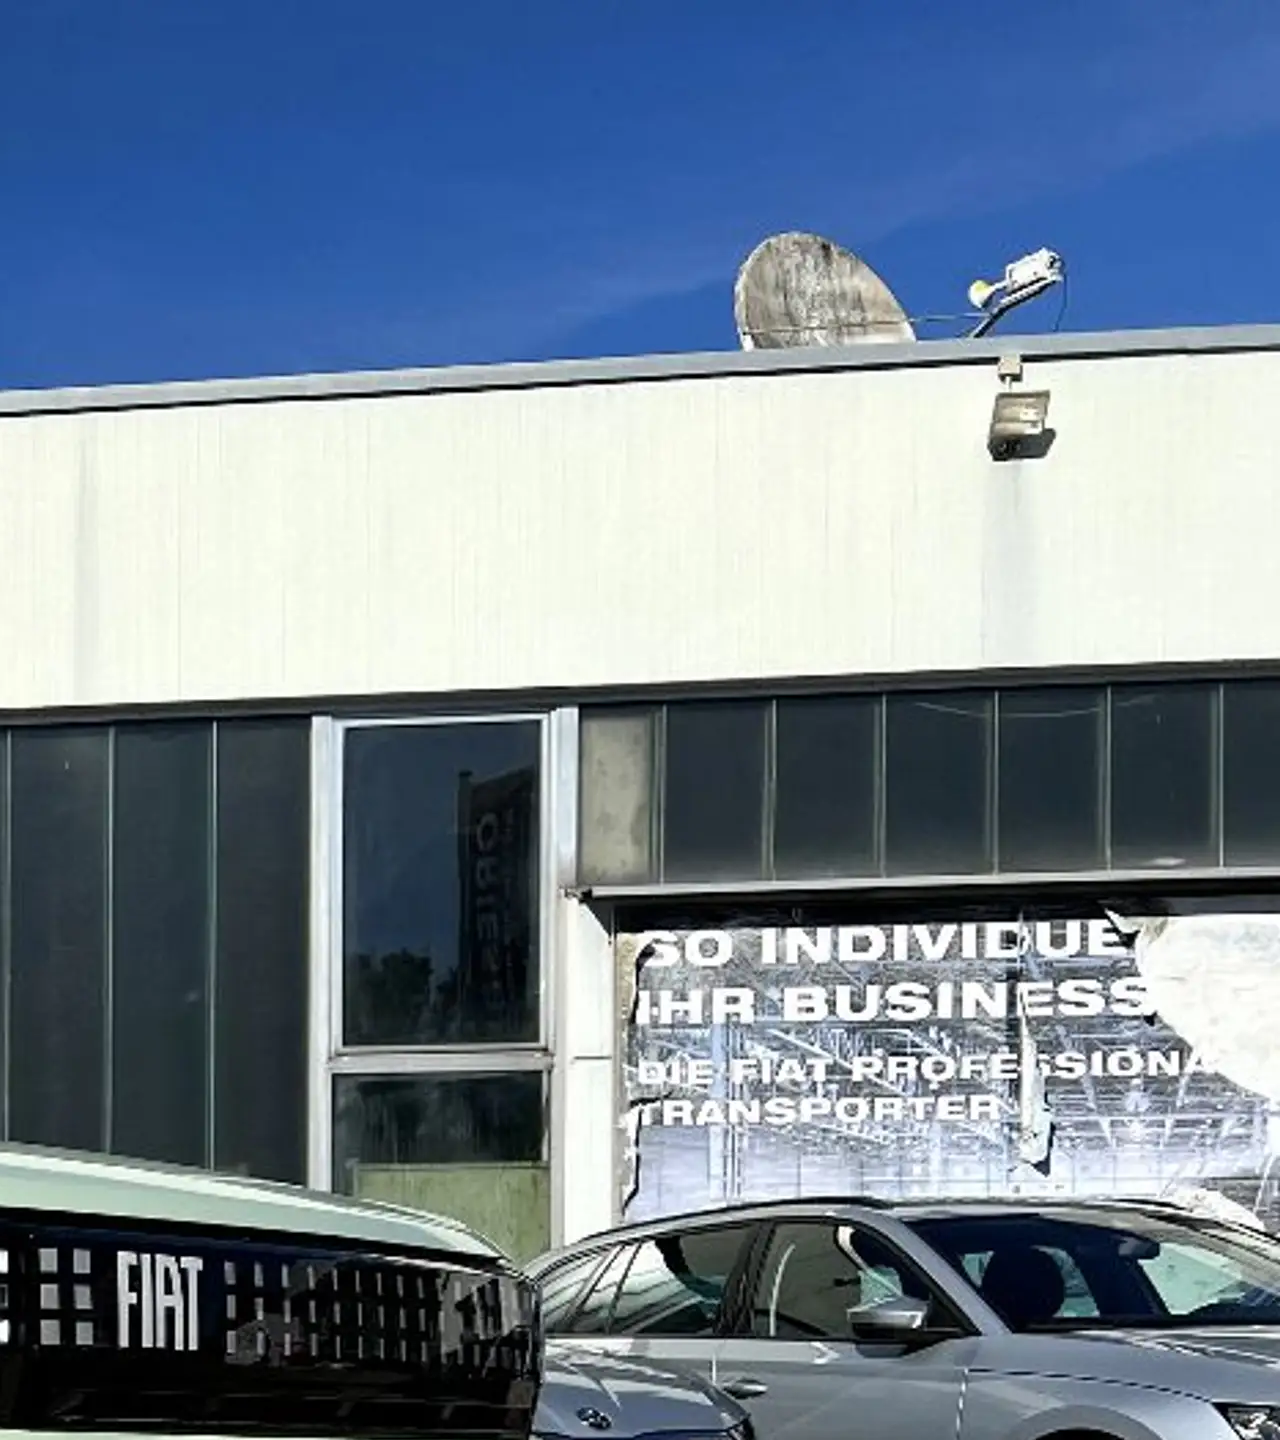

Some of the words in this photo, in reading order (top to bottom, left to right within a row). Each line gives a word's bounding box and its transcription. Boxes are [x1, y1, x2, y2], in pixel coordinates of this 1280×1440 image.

[636, 986, 756, 1024] IHR
[783, 975, 1156, 1022] BUSINESS
[638, 1060, 714, 1086] DIE
[732, 1057, 833, 1084] FIAT
[634, 1094, 1010, 1126] TRANSPORTER
[117, 1250, 203, 1351] FIAT
